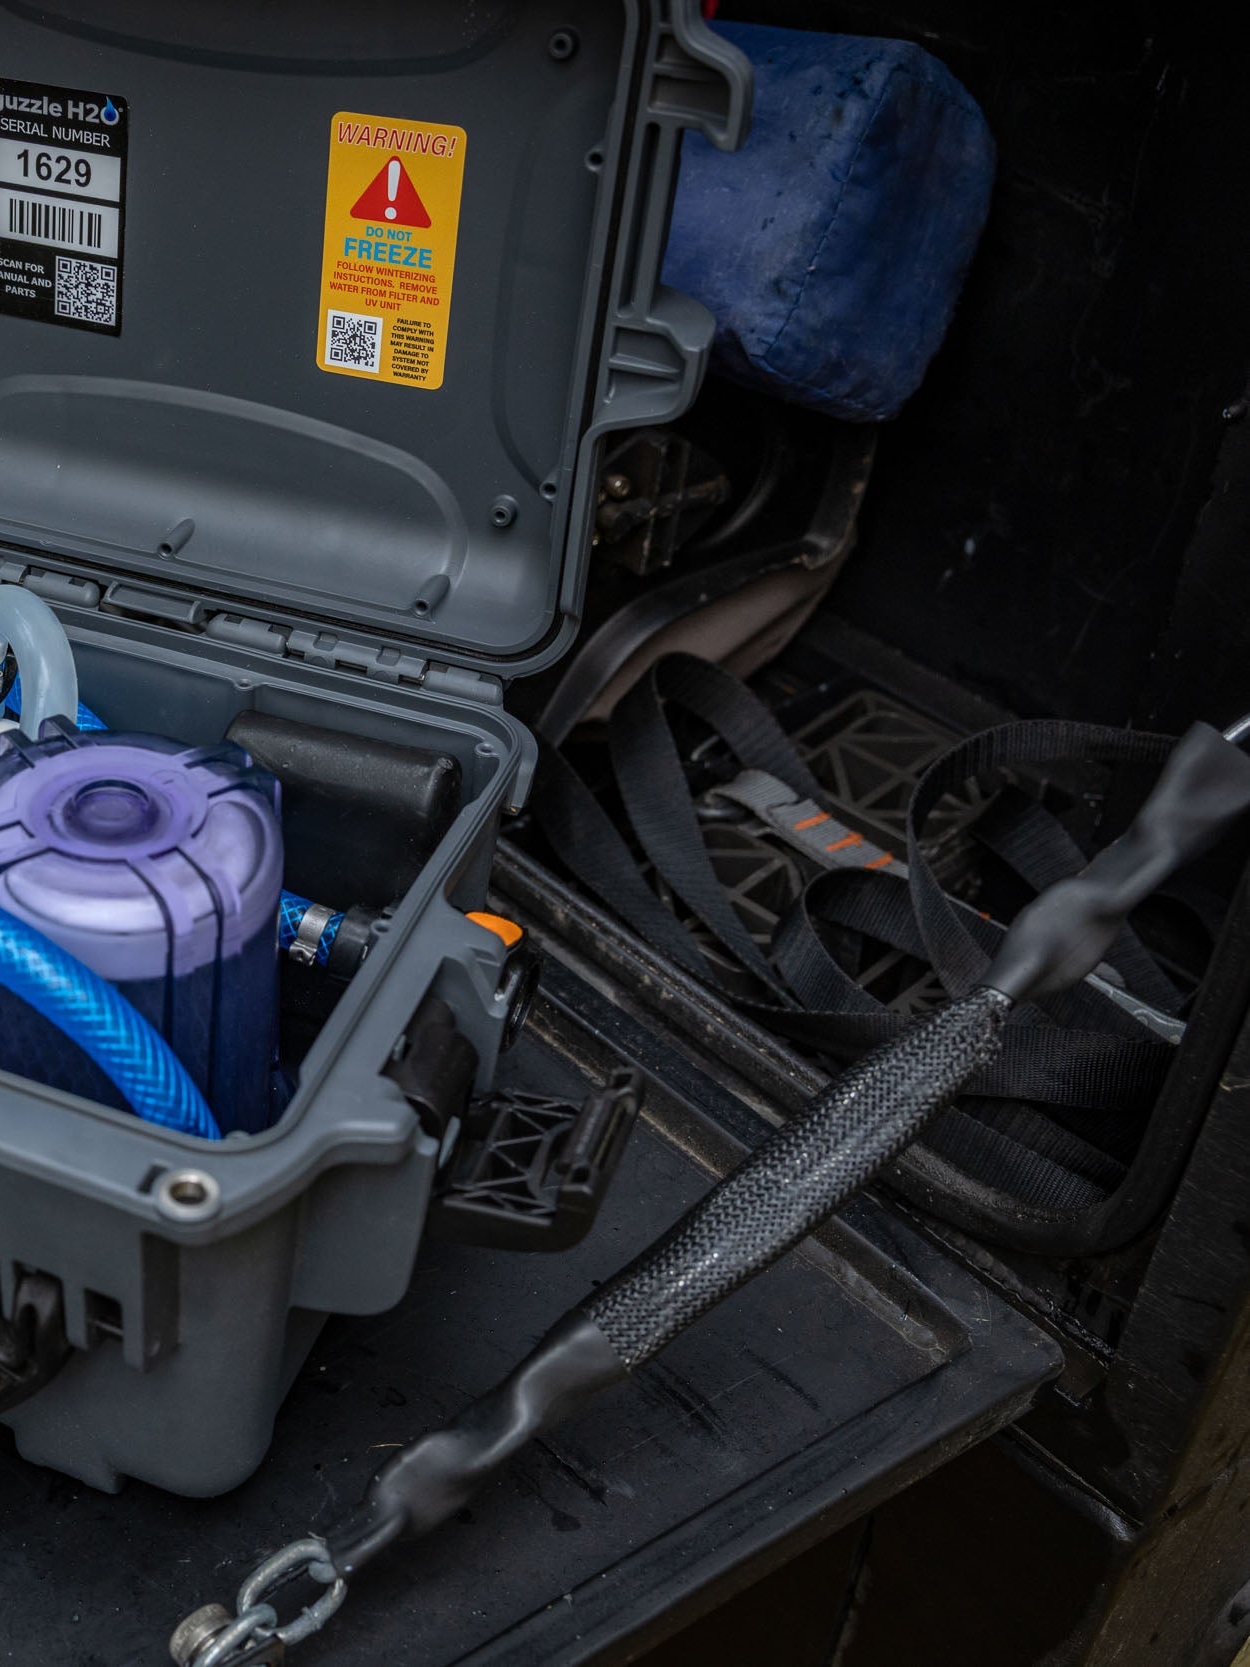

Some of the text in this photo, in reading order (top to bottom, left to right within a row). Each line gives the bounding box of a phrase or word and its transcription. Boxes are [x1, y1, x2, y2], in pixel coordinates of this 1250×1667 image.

[0, 117, 110, 148] SERIAL NUMBER
[337, 121, 457, 158] WARNING!
[17, 148, 92, 188] 1629
[366, 226, 412, 242] DO NOT
[344, 237, 432, 269] FREEZE
[25, 262, 45, 274] FOR
[336, 260, 436, 283] FOLLOW WINTERIZING
[31, 277, 52, 288] AND
[334, 271, 438, 295] INSTUCTIONS. REMOVE
[5, 284, 37, 298] PARTS
[330, 281, 440, 306] WATER FROM FILTER AND
[365, 298, 402, 312] UV UNIT
[397, 318, 422, 327] FAILURE
[392, 325, 434, 337] COMPLY WITH
[406, 335, 434, 344] WARNING
[394, 348, 420, 358] DAMAGE
[404, 343, 426, 351] RESULT
[392, 356, 416, 365] SYSTEM
[392, 363, 420, 373] COVERED
[393, 371, 426, 381] WARRANTY
